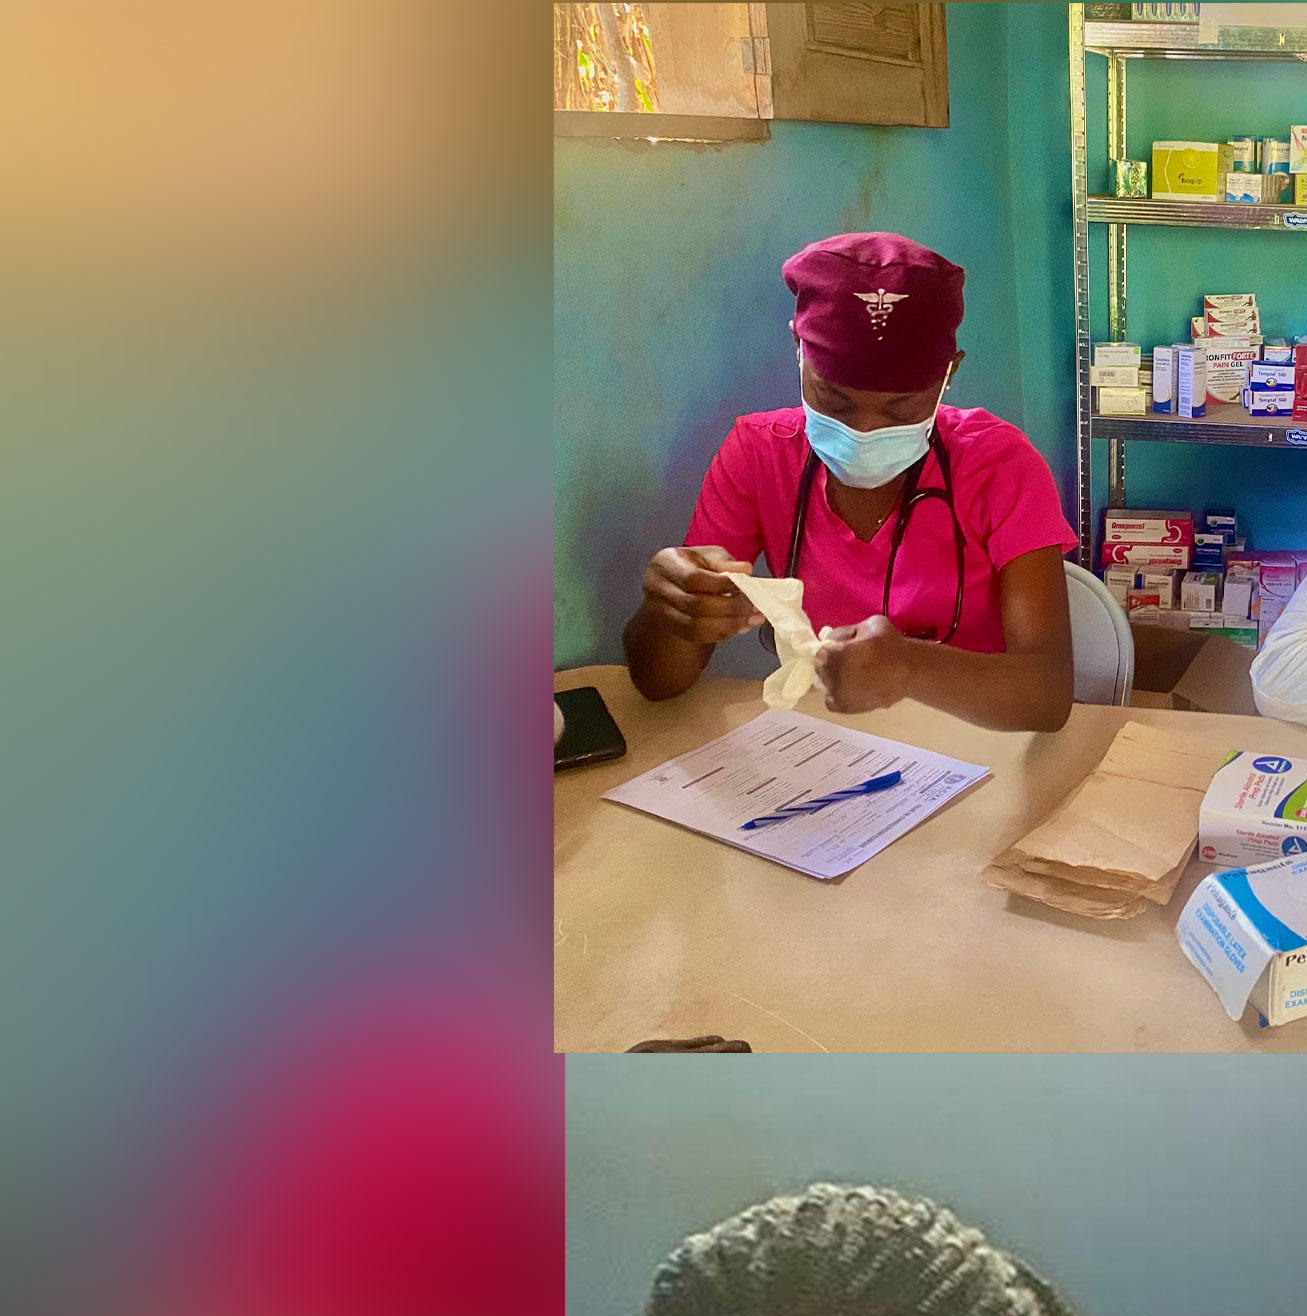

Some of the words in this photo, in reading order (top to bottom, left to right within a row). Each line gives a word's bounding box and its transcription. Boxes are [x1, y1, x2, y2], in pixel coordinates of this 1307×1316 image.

[1232, 352, 1254, 360] FORTE
[1236, 829, 1255, 837] Sterile
[1256, 832, 1280, 840] Alcohol
[1248, 837, 1263, 845] Prep
[1203, 848, 1216, 858] 200
[1202, 902, 1232, 941] DISPOSABLE
[1230, 938, 1248, 962] LATEX
[1195, 908, 1226, 950] EXAMINATION
[1224, 944, 1246, 974] GLOVES
